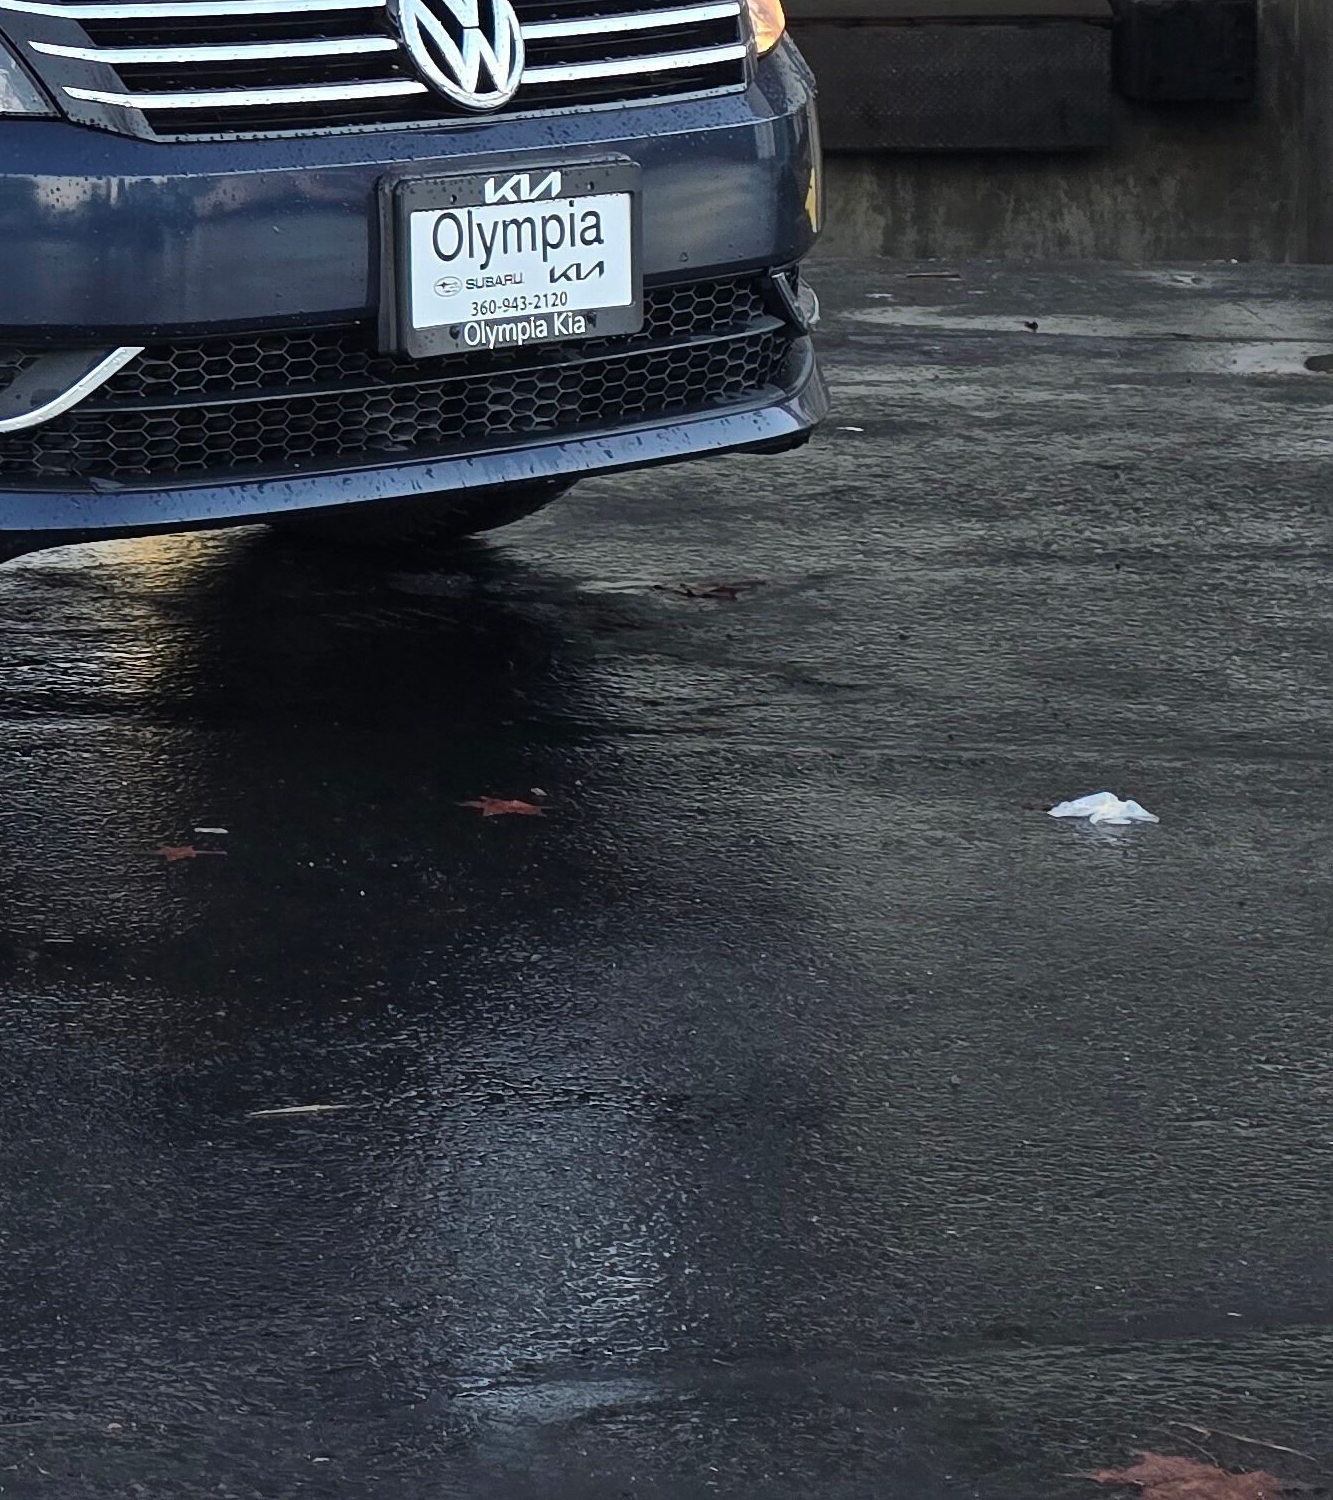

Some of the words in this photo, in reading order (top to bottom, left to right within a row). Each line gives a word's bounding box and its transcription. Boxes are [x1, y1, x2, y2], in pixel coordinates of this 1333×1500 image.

[432, 200, 604, 270] Olympia
[465, 271, 524, 290] SUBARU
[471, 290, 568, 317] 360-943-2120
[464, 316, 548, 350] Olympia
[553, 311, 586, 336] Kia
